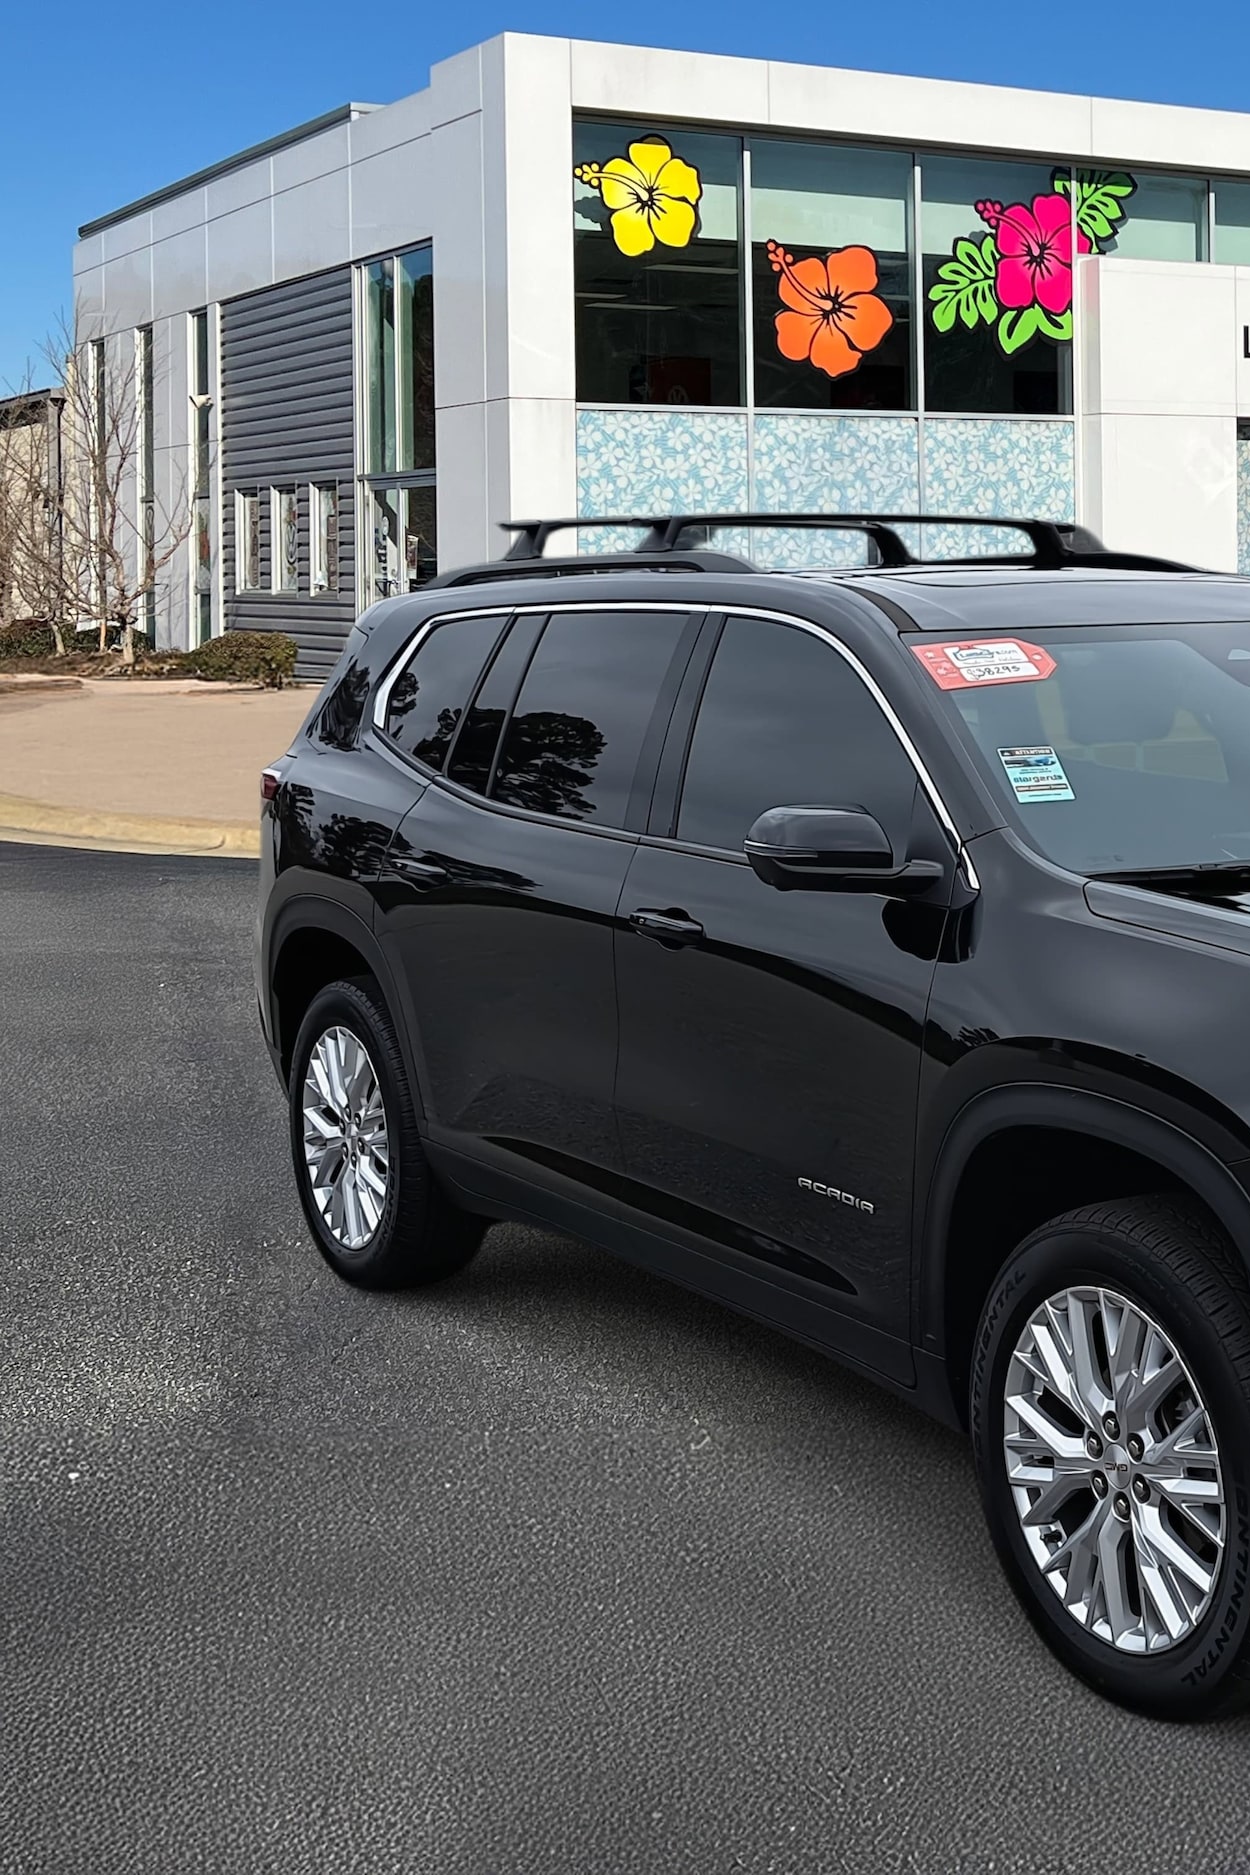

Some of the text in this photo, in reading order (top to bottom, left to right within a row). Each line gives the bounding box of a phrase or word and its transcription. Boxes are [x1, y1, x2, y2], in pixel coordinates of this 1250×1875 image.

[797, 1177, 874, 1215] ACADIA
[971, 1269, 1027, 1474] ONTINENTAL
[1180, 1464, 1250, 1686] ONTINENTAL
